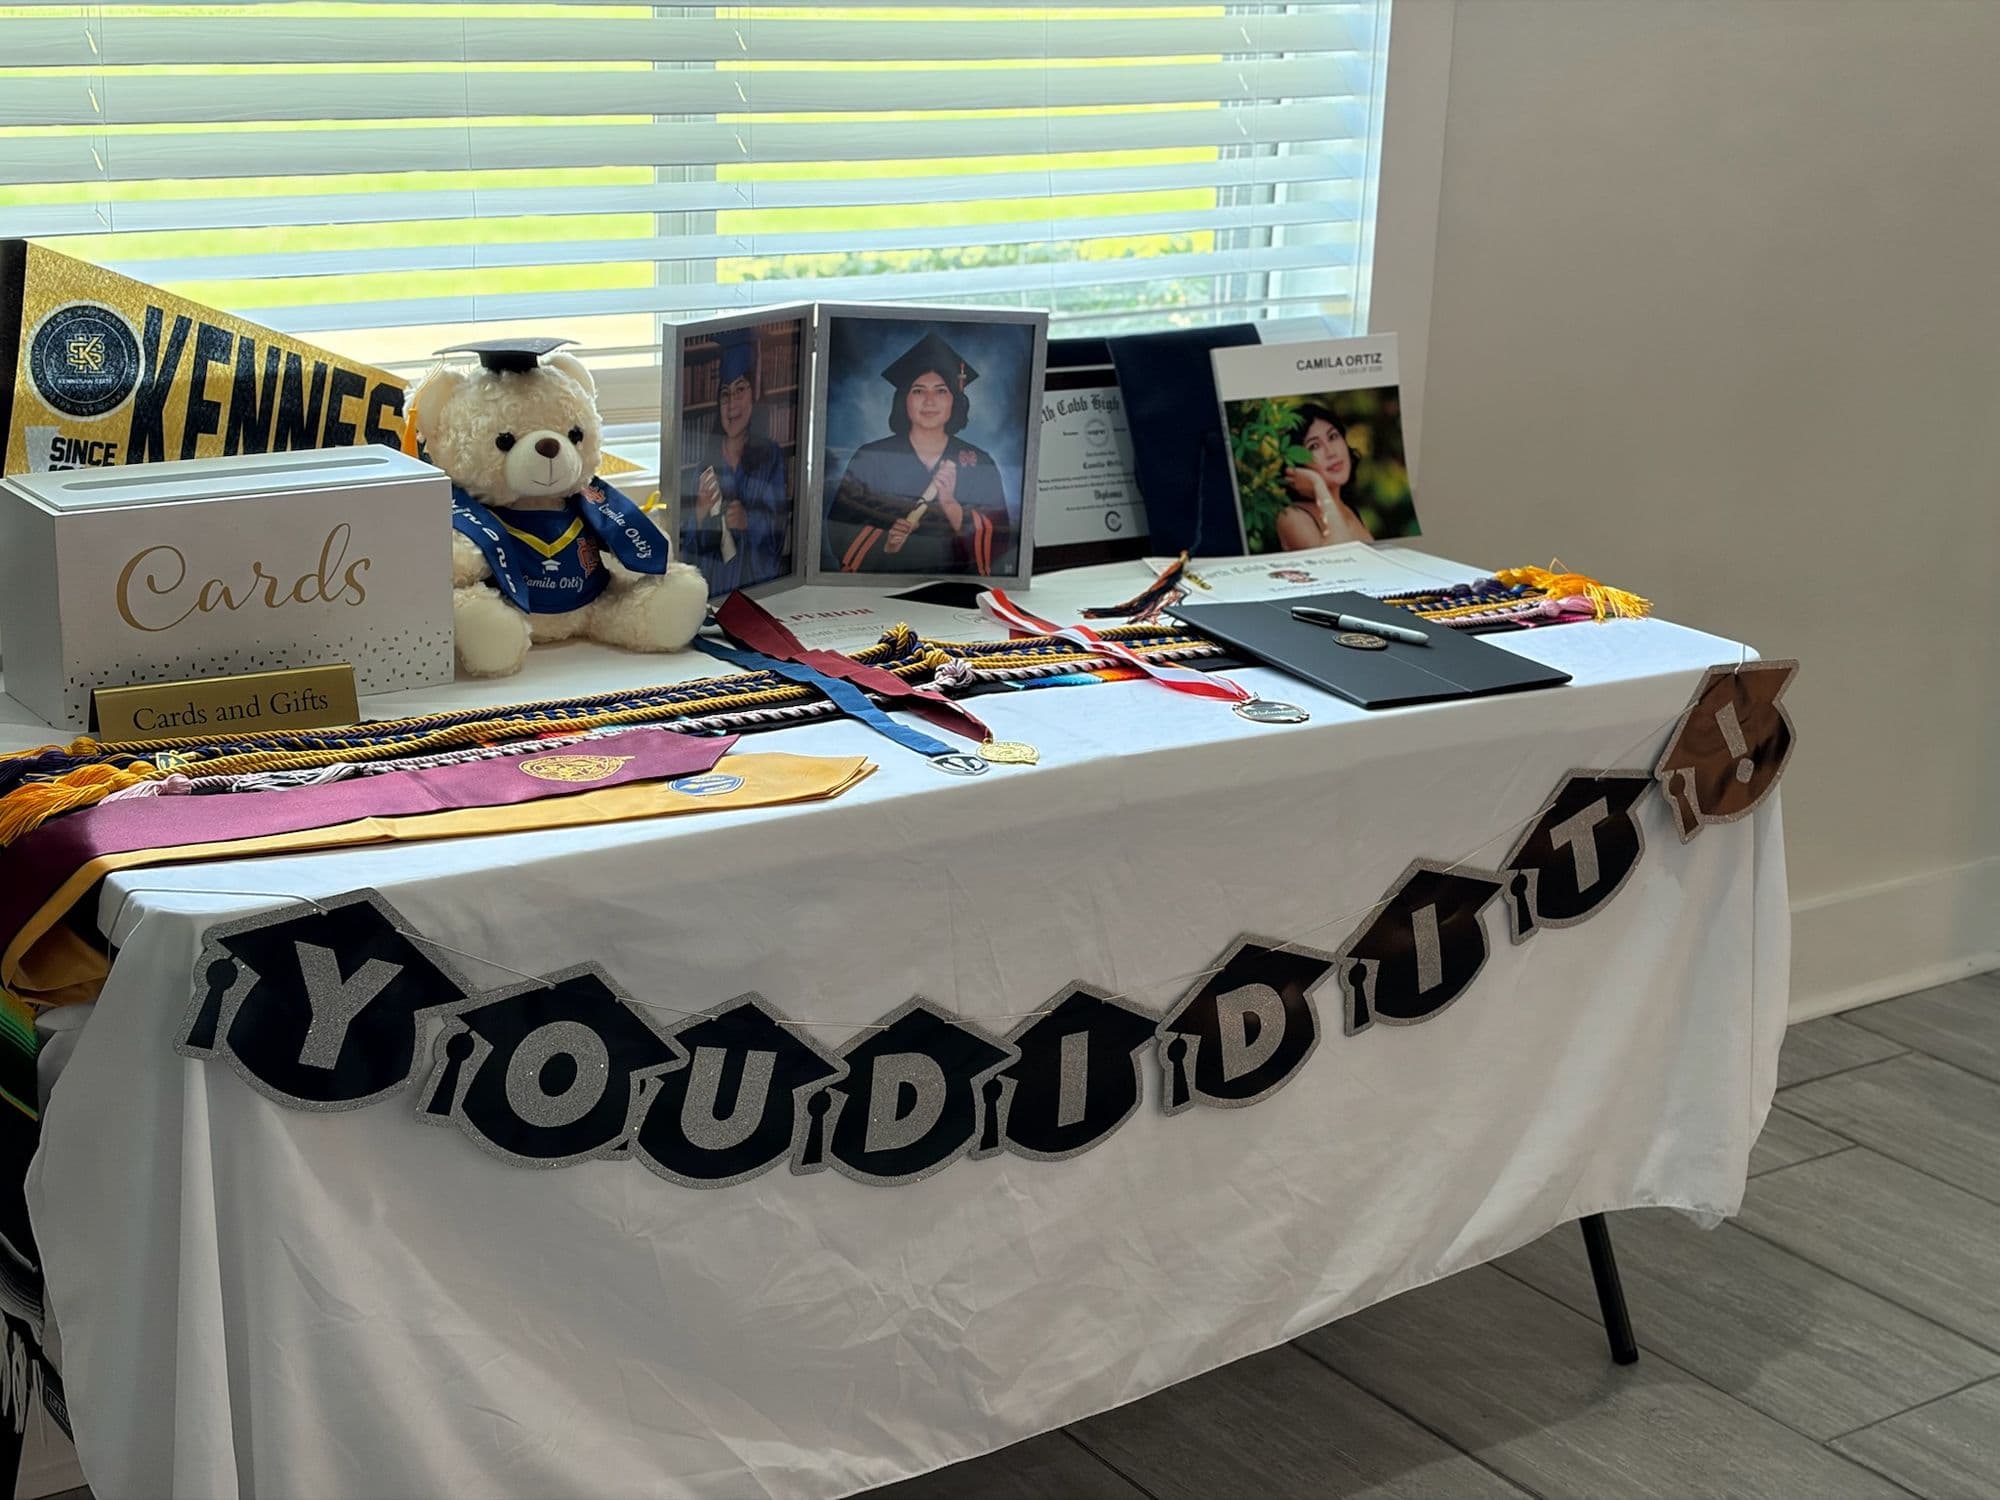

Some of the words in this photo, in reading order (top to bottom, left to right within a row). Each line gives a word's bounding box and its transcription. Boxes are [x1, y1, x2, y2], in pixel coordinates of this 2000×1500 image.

[1296, 357, 1343, 371] CAMILA
[1345, 352, 1383, 367] ORTIZ
[49, 436, 118, 466] SINCE
[625, 528, 652, 559] Ortiz
[116, 522, 371, 632] Cards
[522, 575, 556, 590] Camila
[559, 575, 584, 593] Ortiz
[133, 702, 208, 733] Cards
[216, 693, 262, 721] and
[269, 688, 329, 715] Gifts
